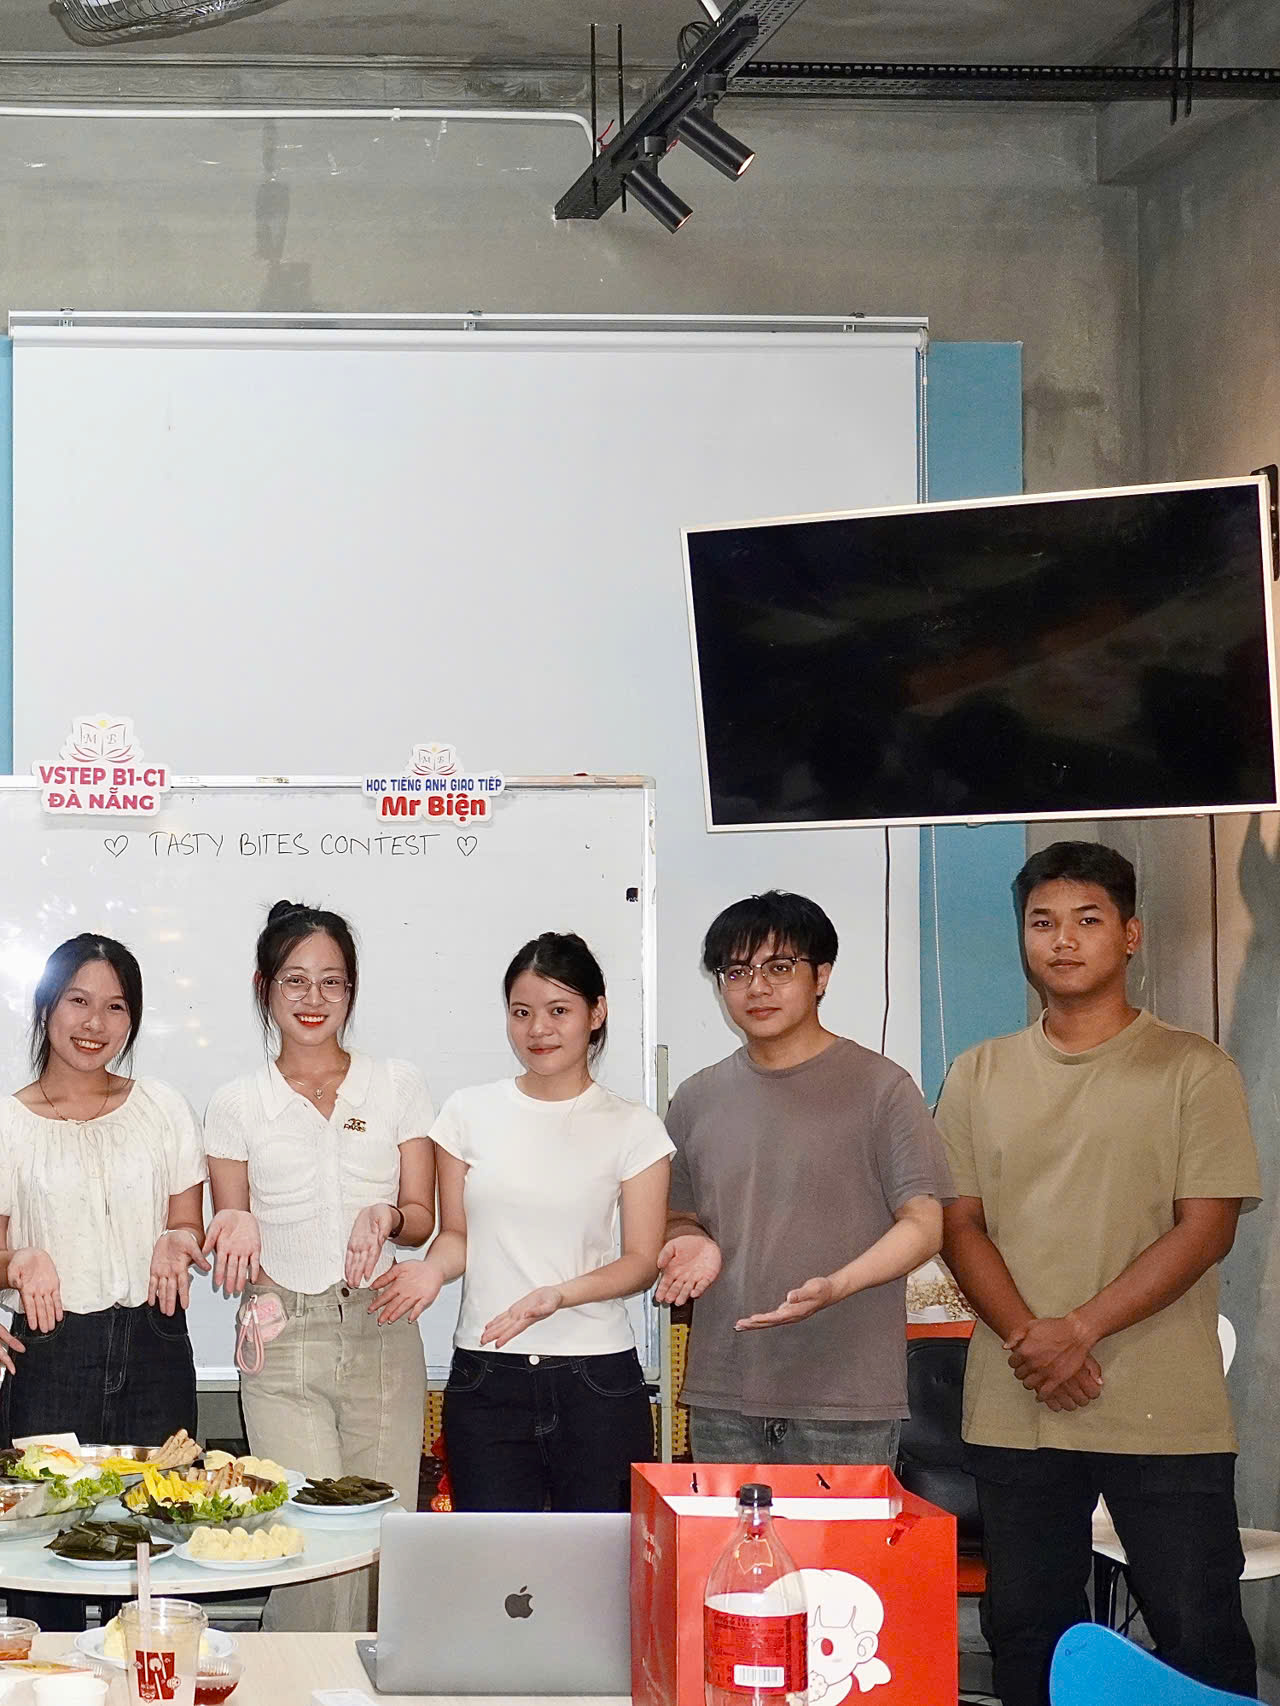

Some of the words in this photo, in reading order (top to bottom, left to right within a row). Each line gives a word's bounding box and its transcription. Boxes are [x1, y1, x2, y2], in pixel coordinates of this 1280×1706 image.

[39, 766, 107, 786] VSTEP
[112, 768, 166, 787] B1-C1
[390, 775, 421, 792] TIẾNG
[425, 779, 447, 792] ANH
[450, 779, 474, 792] GIAO
[478, 775, 502, 792] TIẾP
[48, 789, 83, 808] ĐÀ
[381, 796, 421, 816] Mr
[427, 793, 486, 822] Biện
[149, 832, 224, 856] TASTY
[239, 832, 310, 856] BITES
[320, 832, 440, 856] CONTEST
